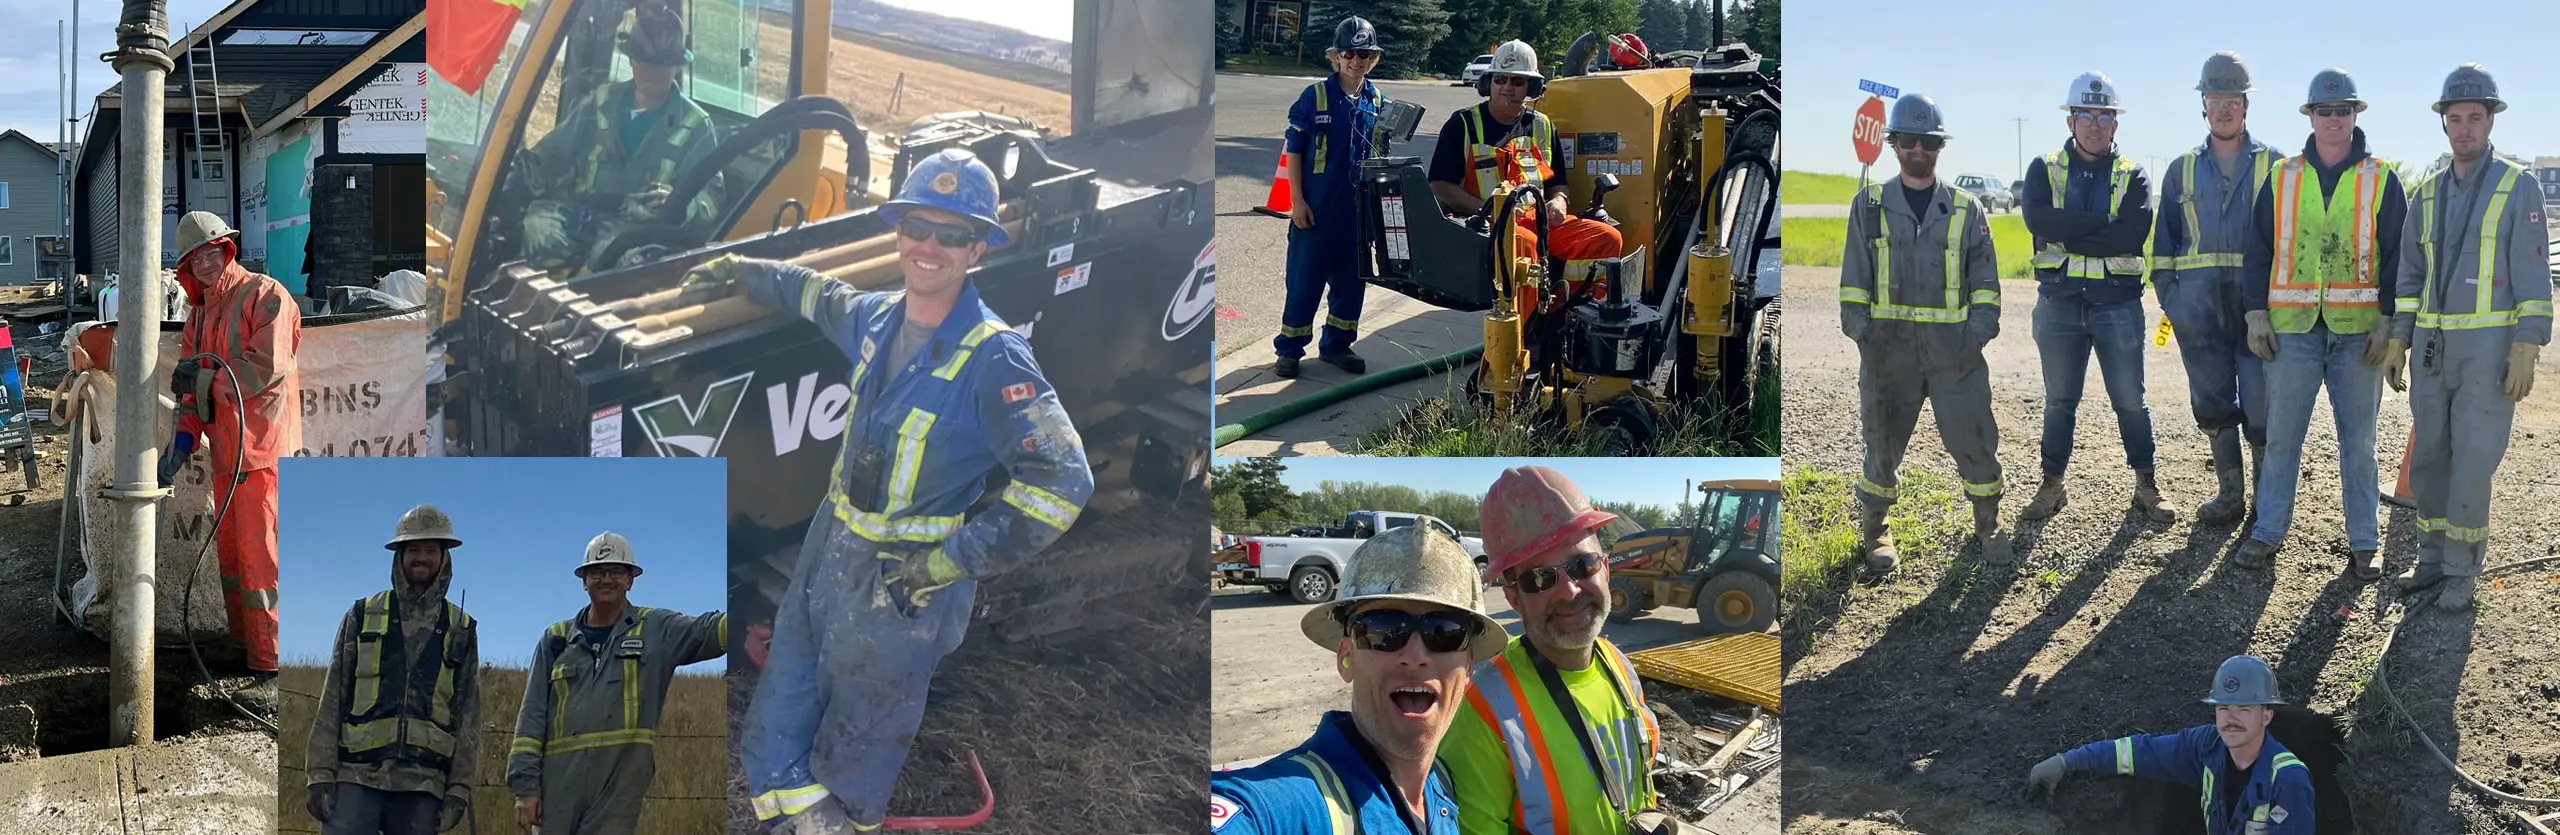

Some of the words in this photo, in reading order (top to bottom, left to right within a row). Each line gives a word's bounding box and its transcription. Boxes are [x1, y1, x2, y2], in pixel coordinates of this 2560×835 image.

[348, 97, 404, 111] GENTEK
[366, 111, 420, 121] GENTEK
[299, 380, 381, 417] BINS
